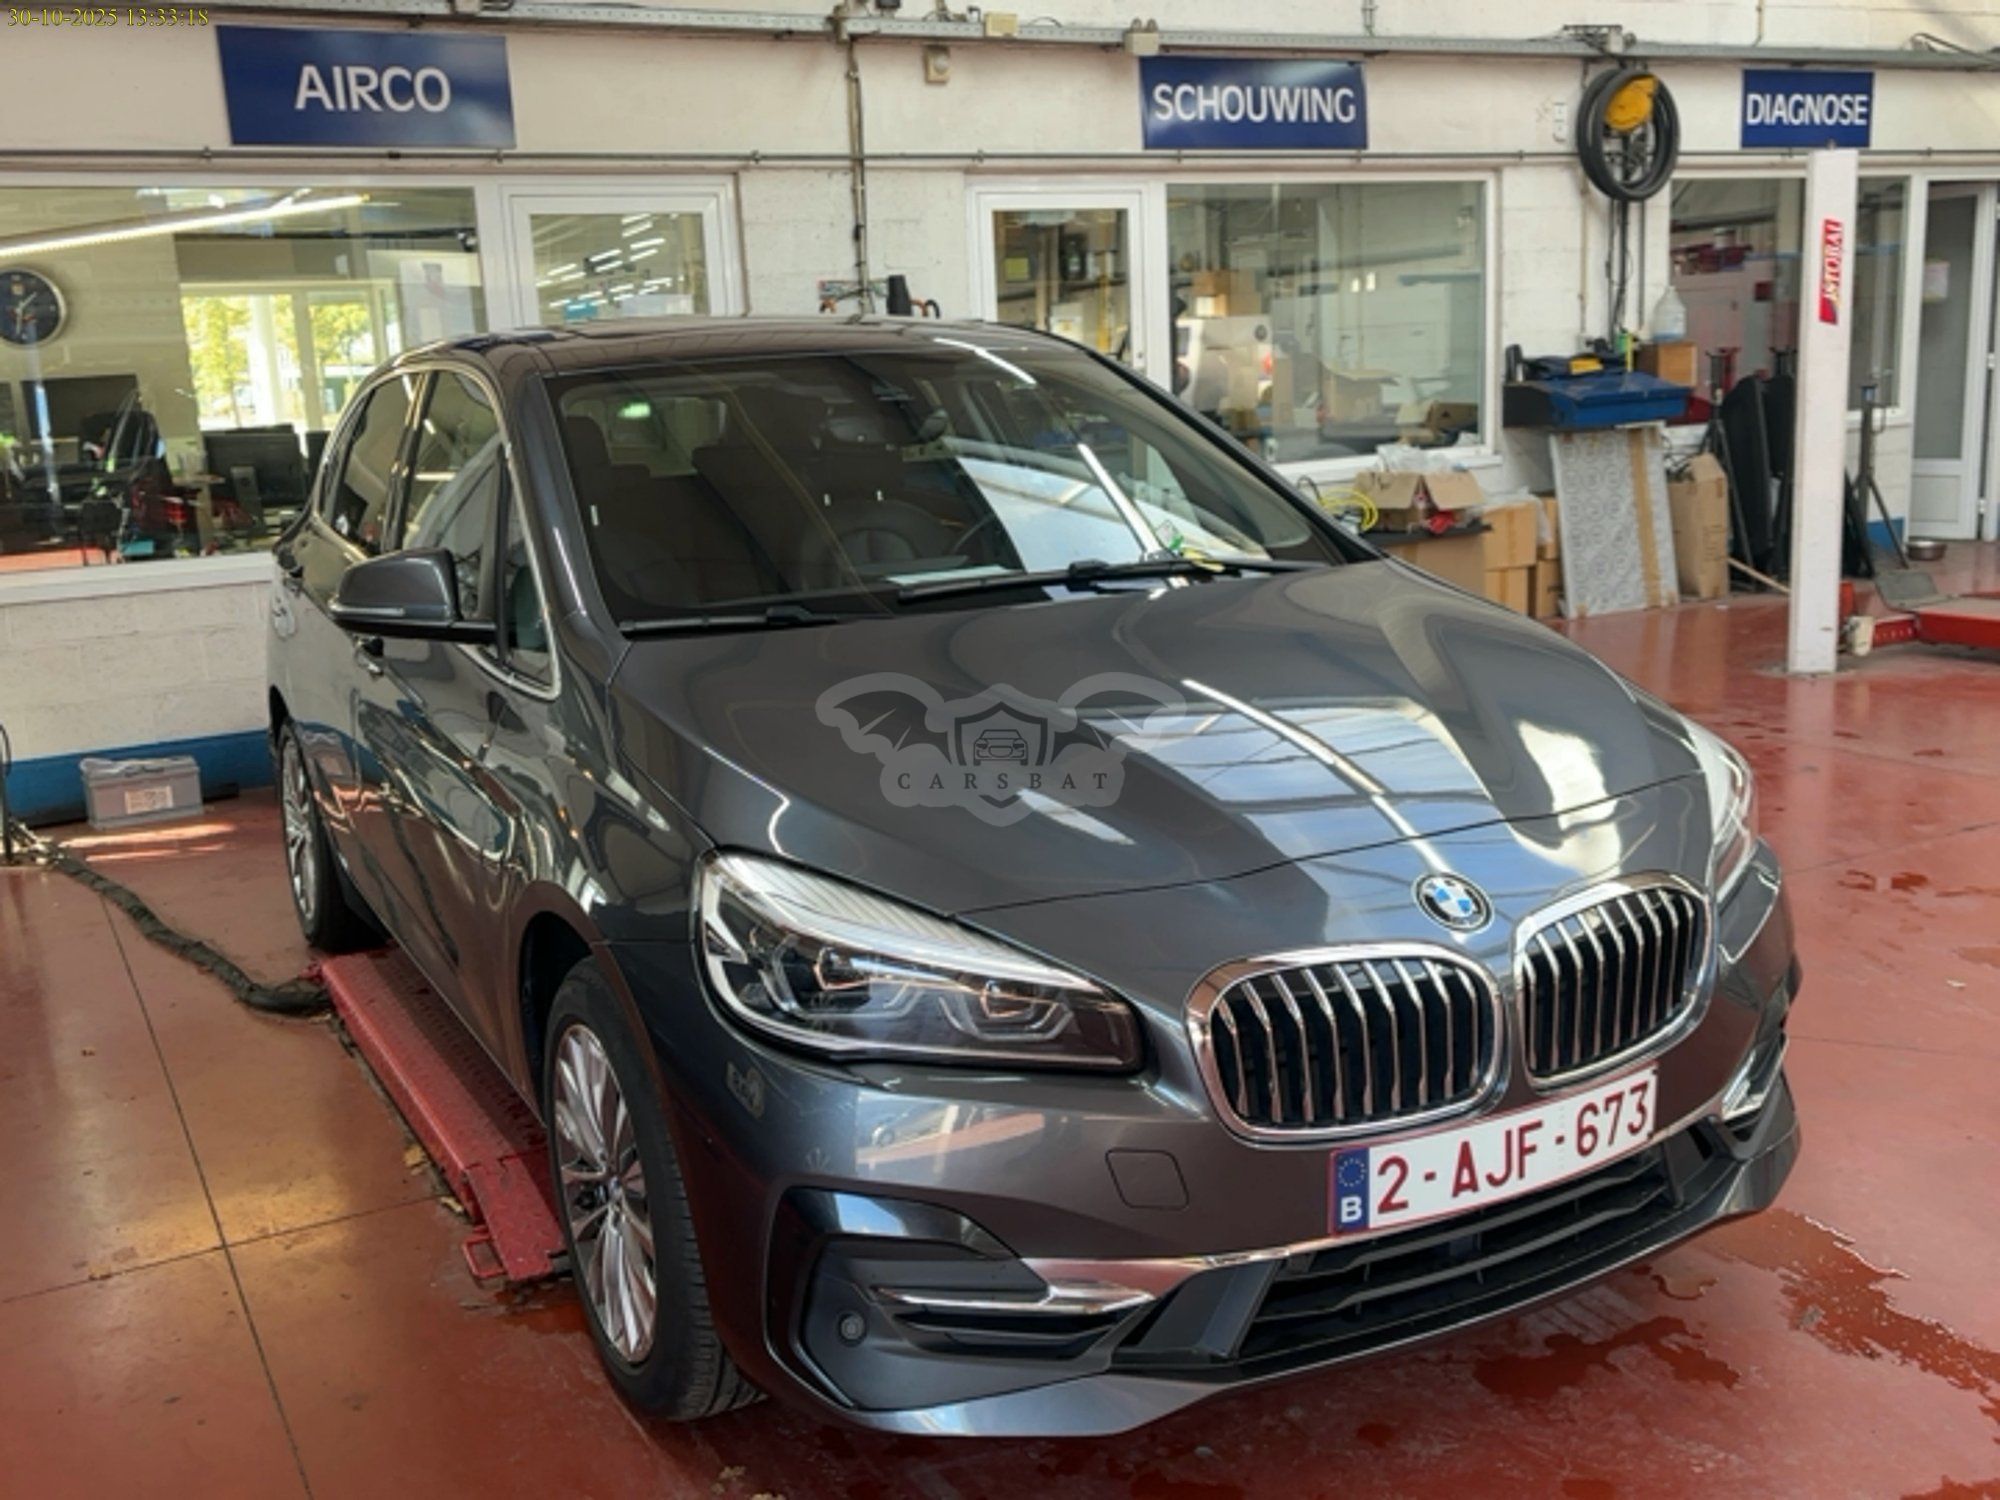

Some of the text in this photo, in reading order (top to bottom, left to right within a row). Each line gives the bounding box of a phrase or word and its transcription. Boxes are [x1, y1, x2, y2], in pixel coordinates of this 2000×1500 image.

[295, 64, 451, 112] AIRCO
[1153, 83, 1356, 123] SCHOUWING
[1746, 93, 1868, 125] DIAGNOSE
[1377, 1081, 1649, 1214] 2-AJF-673
[1340, 1196, 1363, 1223] B
